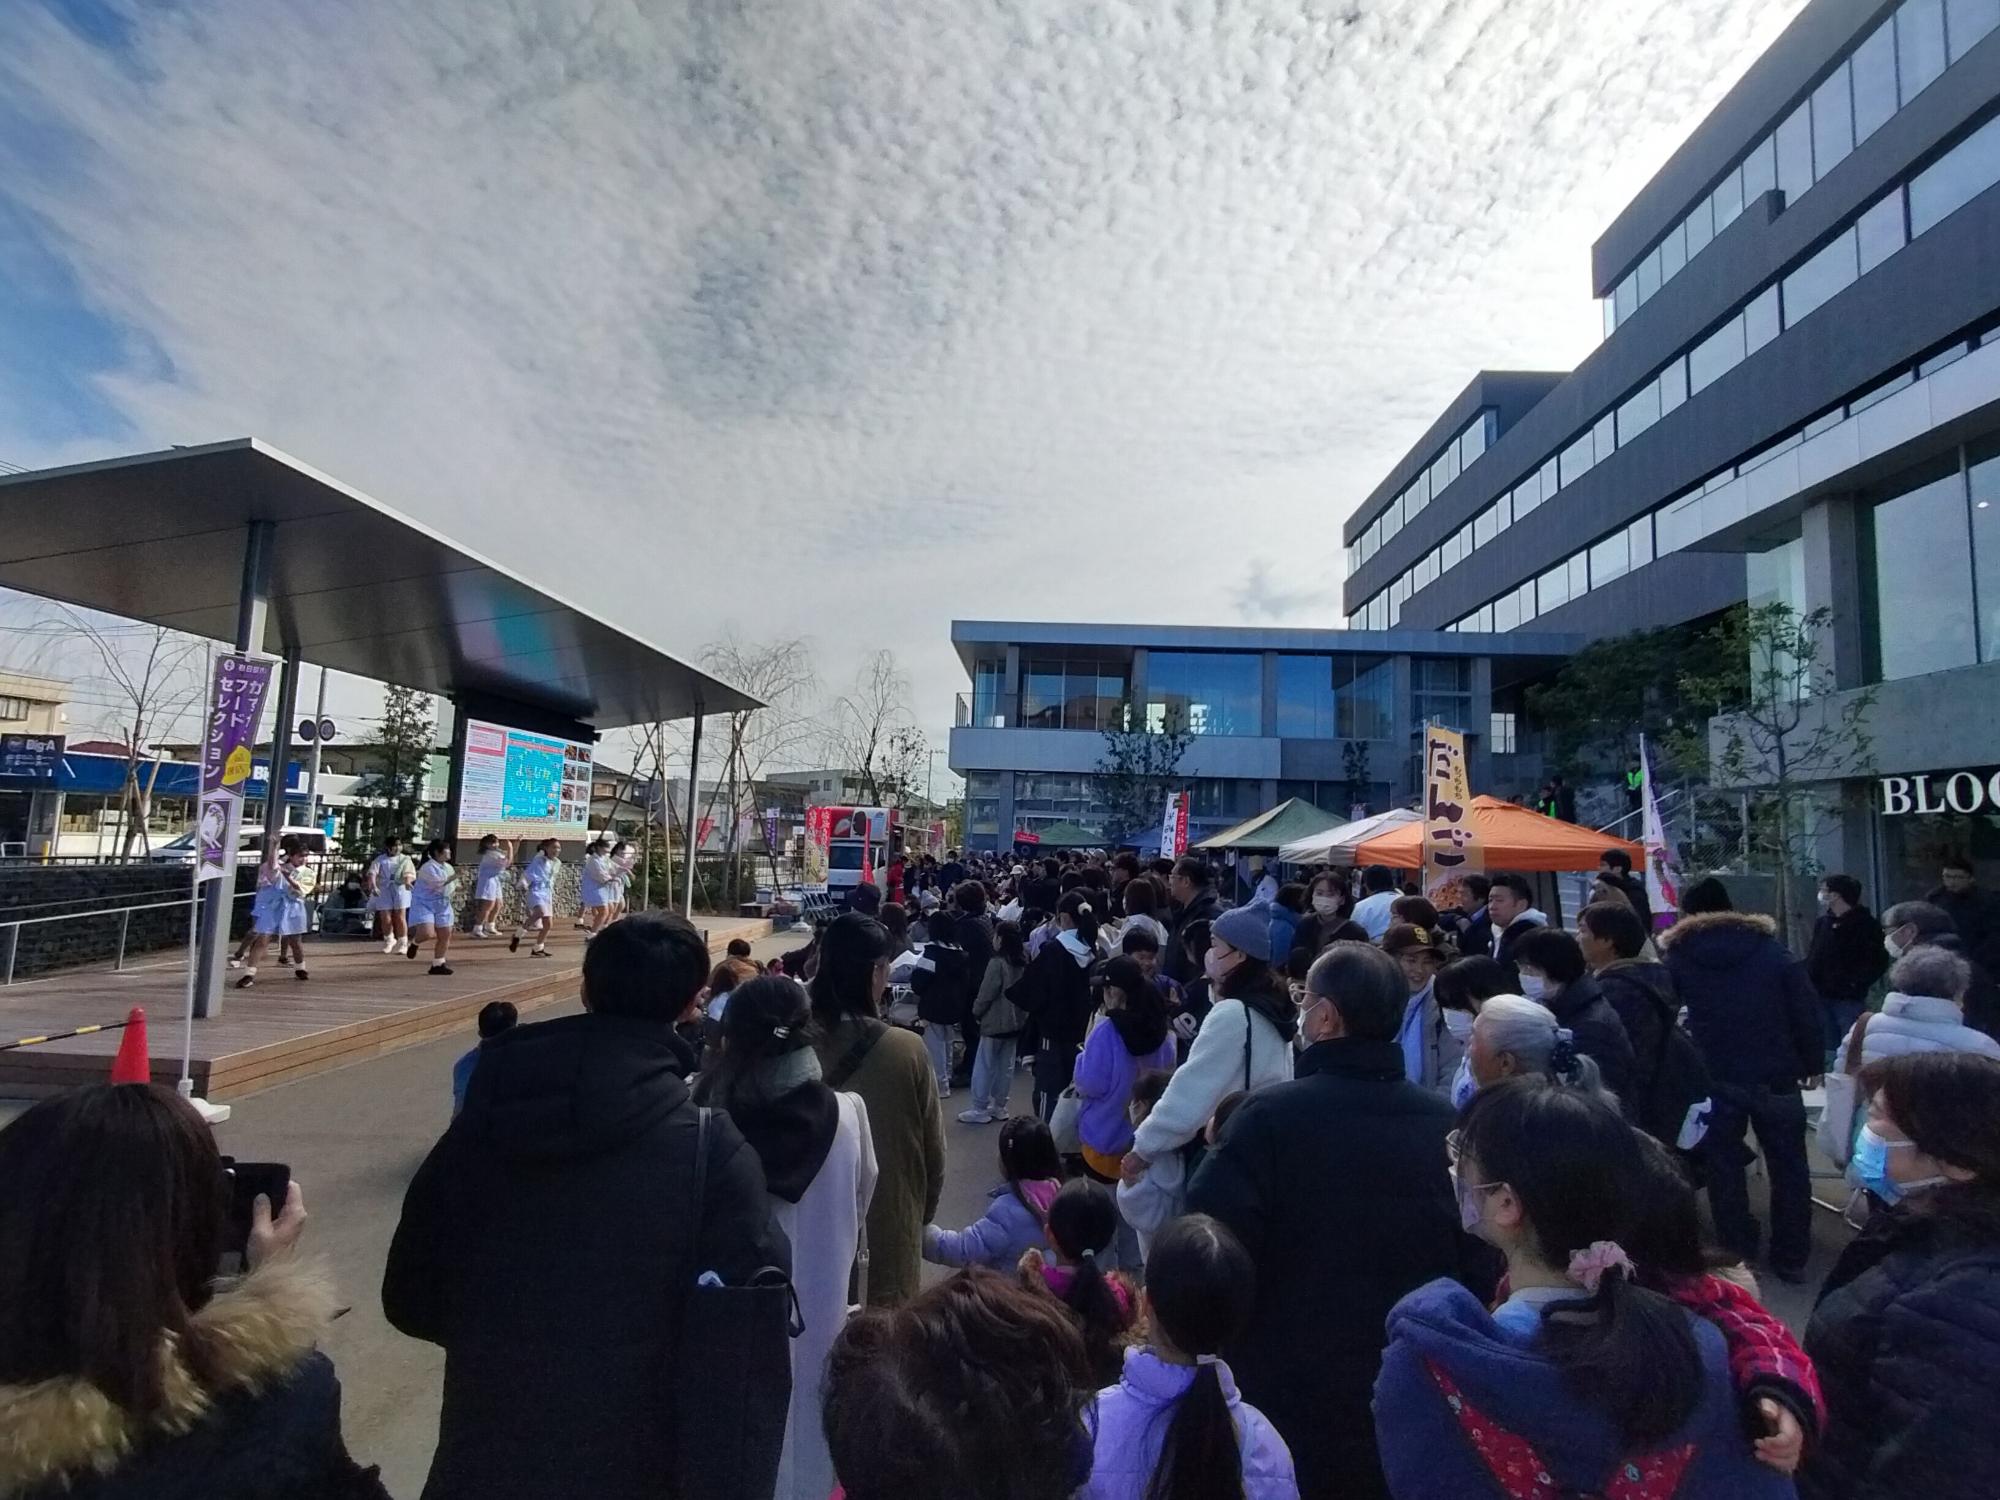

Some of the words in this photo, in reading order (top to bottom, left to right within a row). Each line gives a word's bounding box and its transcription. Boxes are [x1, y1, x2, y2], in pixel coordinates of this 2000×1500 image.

[205, 676, 234, 779] セレクション
[230, 679, 248, 728] フード
[1429, 738, 1473, 867] だんご
